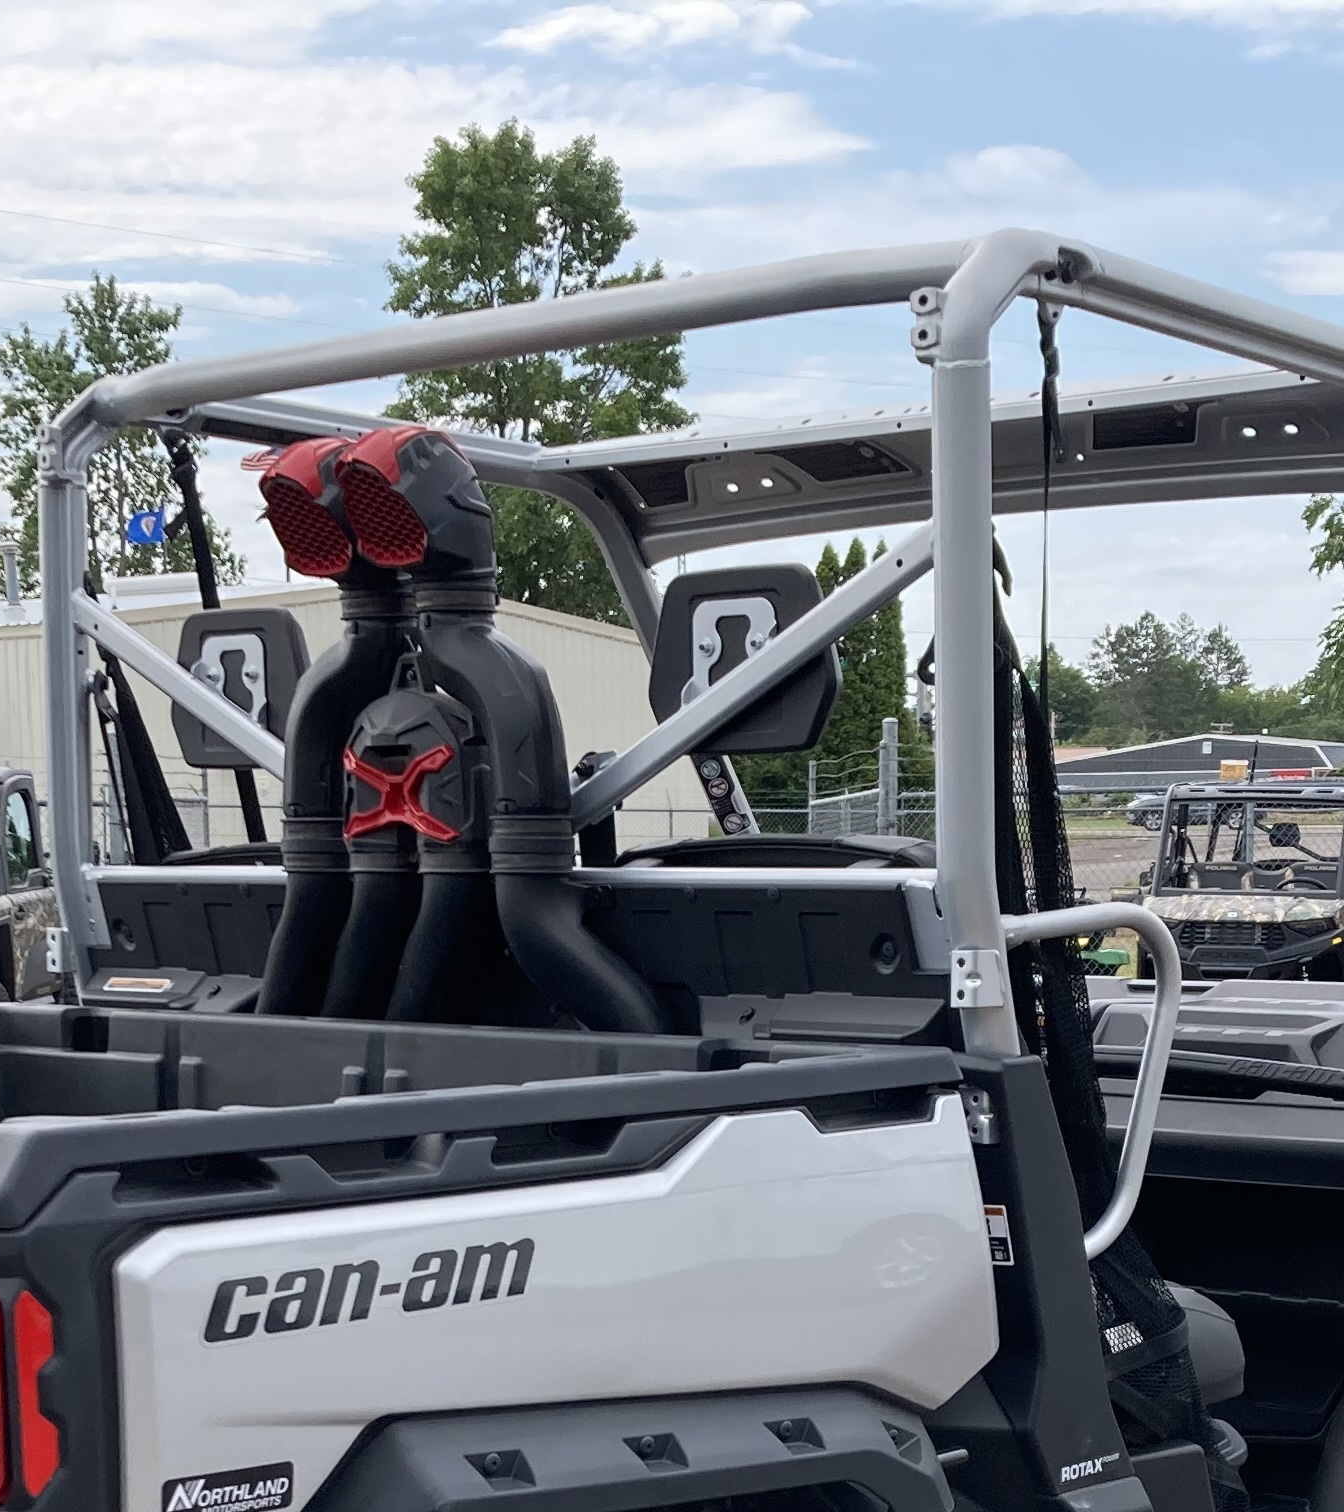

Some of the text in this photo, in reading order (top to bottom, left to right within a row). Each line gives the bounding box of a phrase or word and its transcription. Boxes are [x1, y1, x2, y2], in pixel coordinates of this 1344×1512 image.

[204, 1238, 536, 1343] can-am
[1061, 1457, 1103, 1483] ROTAX
[166, 1477, 290, 1512] NORTHLAND
